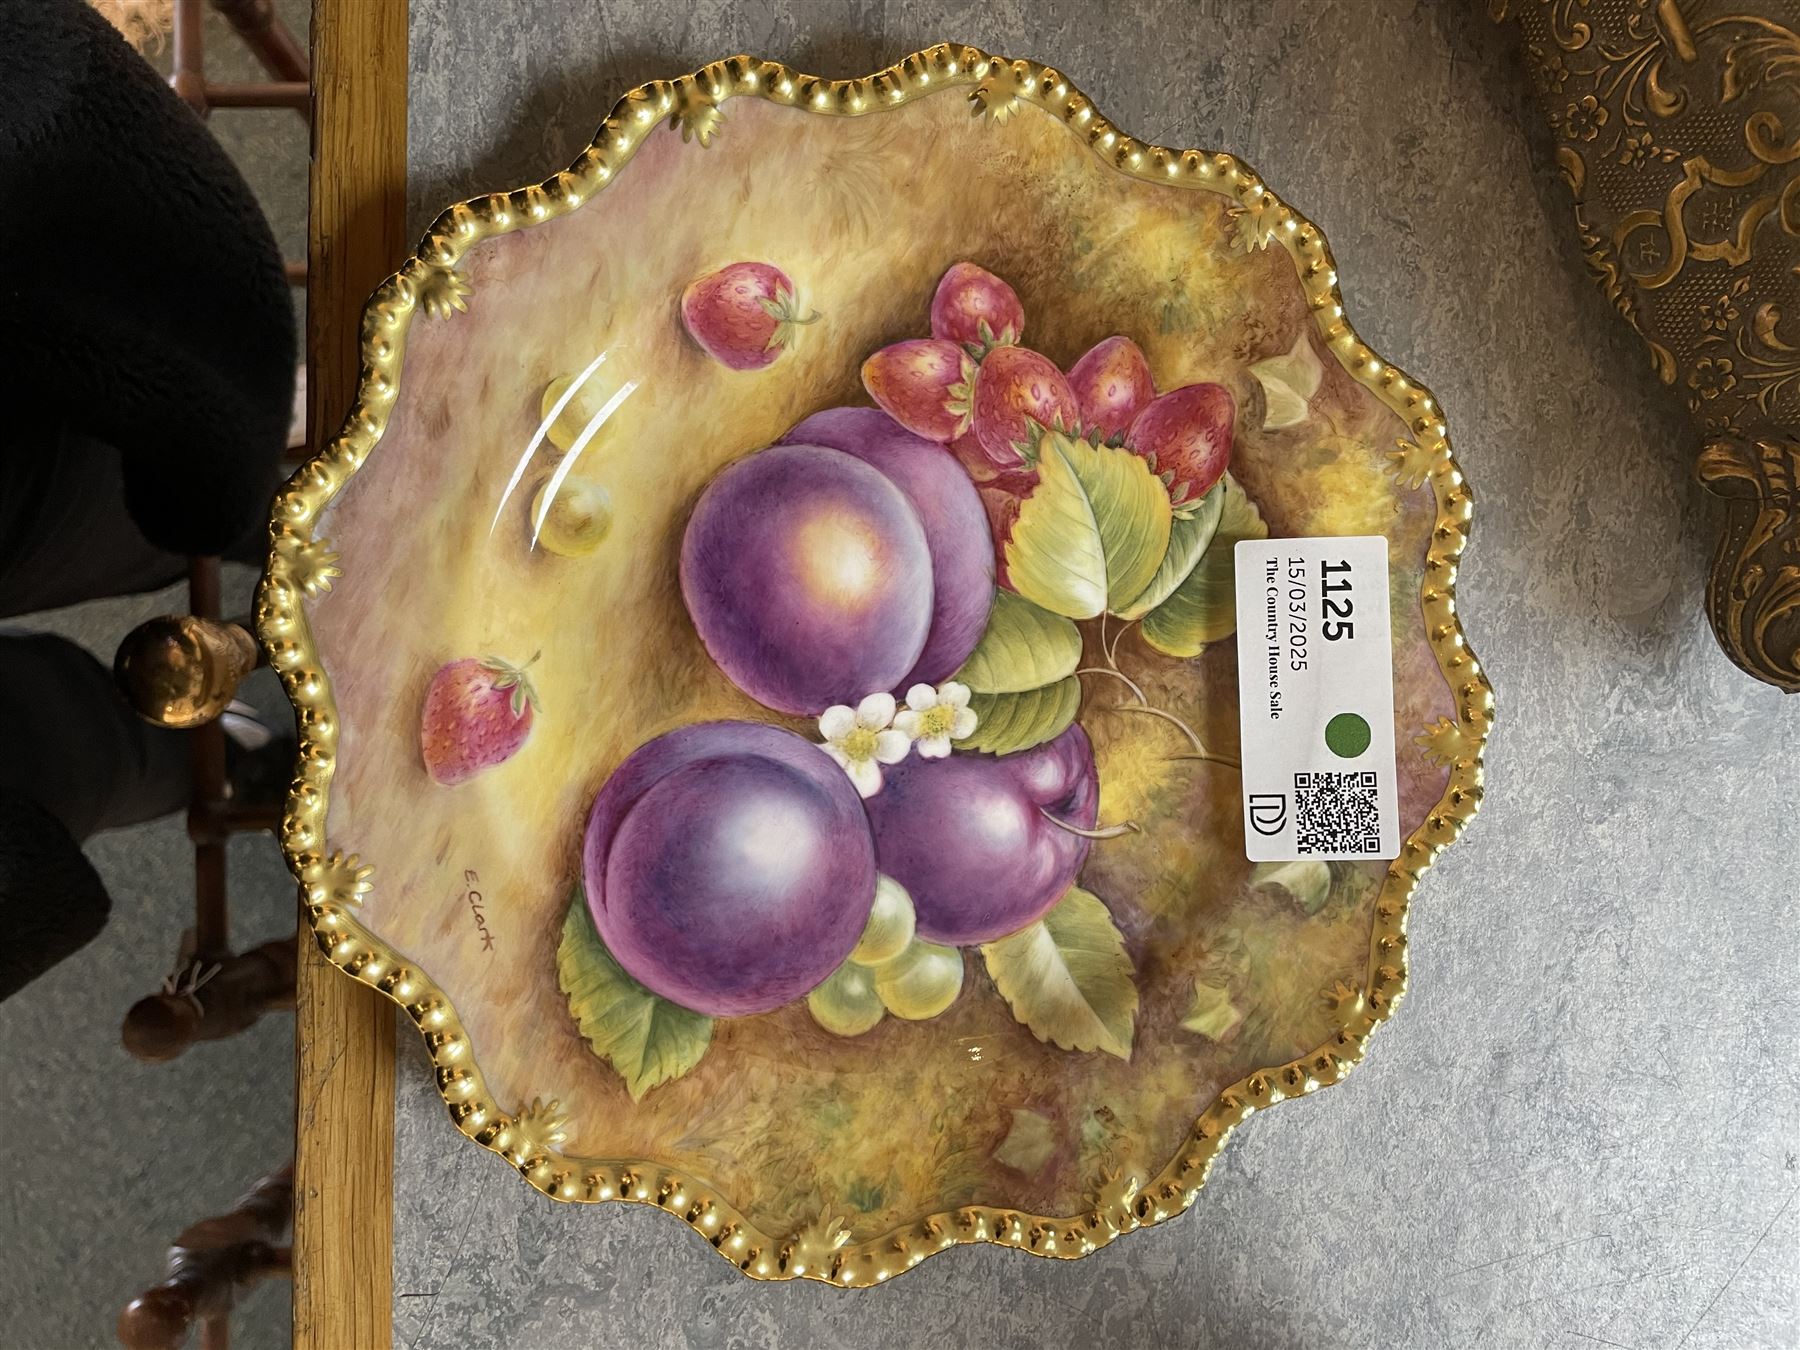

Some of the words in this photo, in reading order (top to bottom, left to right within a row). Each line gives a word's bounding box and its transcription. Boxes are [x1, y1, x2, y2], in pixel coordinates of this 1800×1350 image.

[1266, 557, 1279, 584] The
[1266, 586, 1280, 643] Country
[1288, 557, 1308, 671] 15/03/2025
[1321, 559, 1354, 641] 1125
[1267, 645, 1281, 688] House
[1269, 691, 1283, 720] Sale
